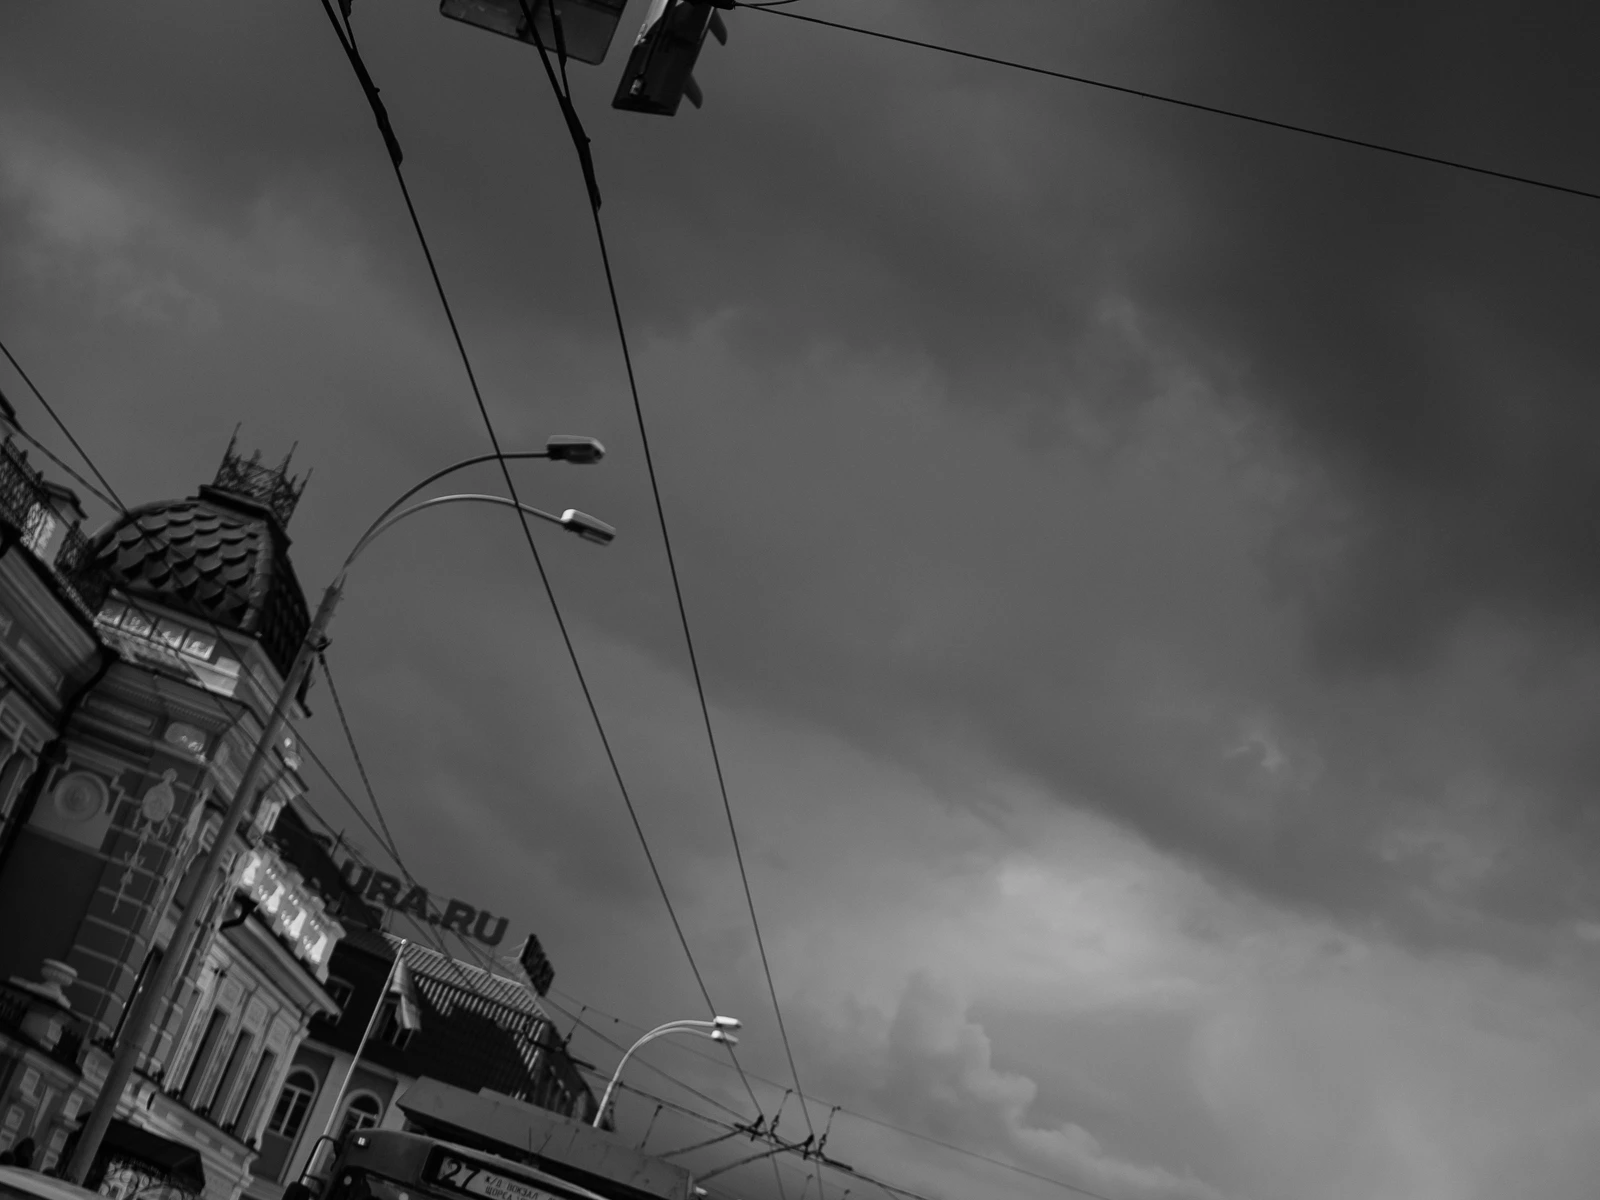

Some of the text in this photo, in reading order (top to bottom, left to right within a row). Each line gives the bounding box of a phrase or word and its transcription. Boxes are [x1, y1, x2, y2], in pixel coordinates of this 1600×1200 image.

[340, 858, 509, 946] URA.RU
[440, 1158, 480, 1190] 27
[506, 1181, 539, 1200] ВОКЗАЛ
